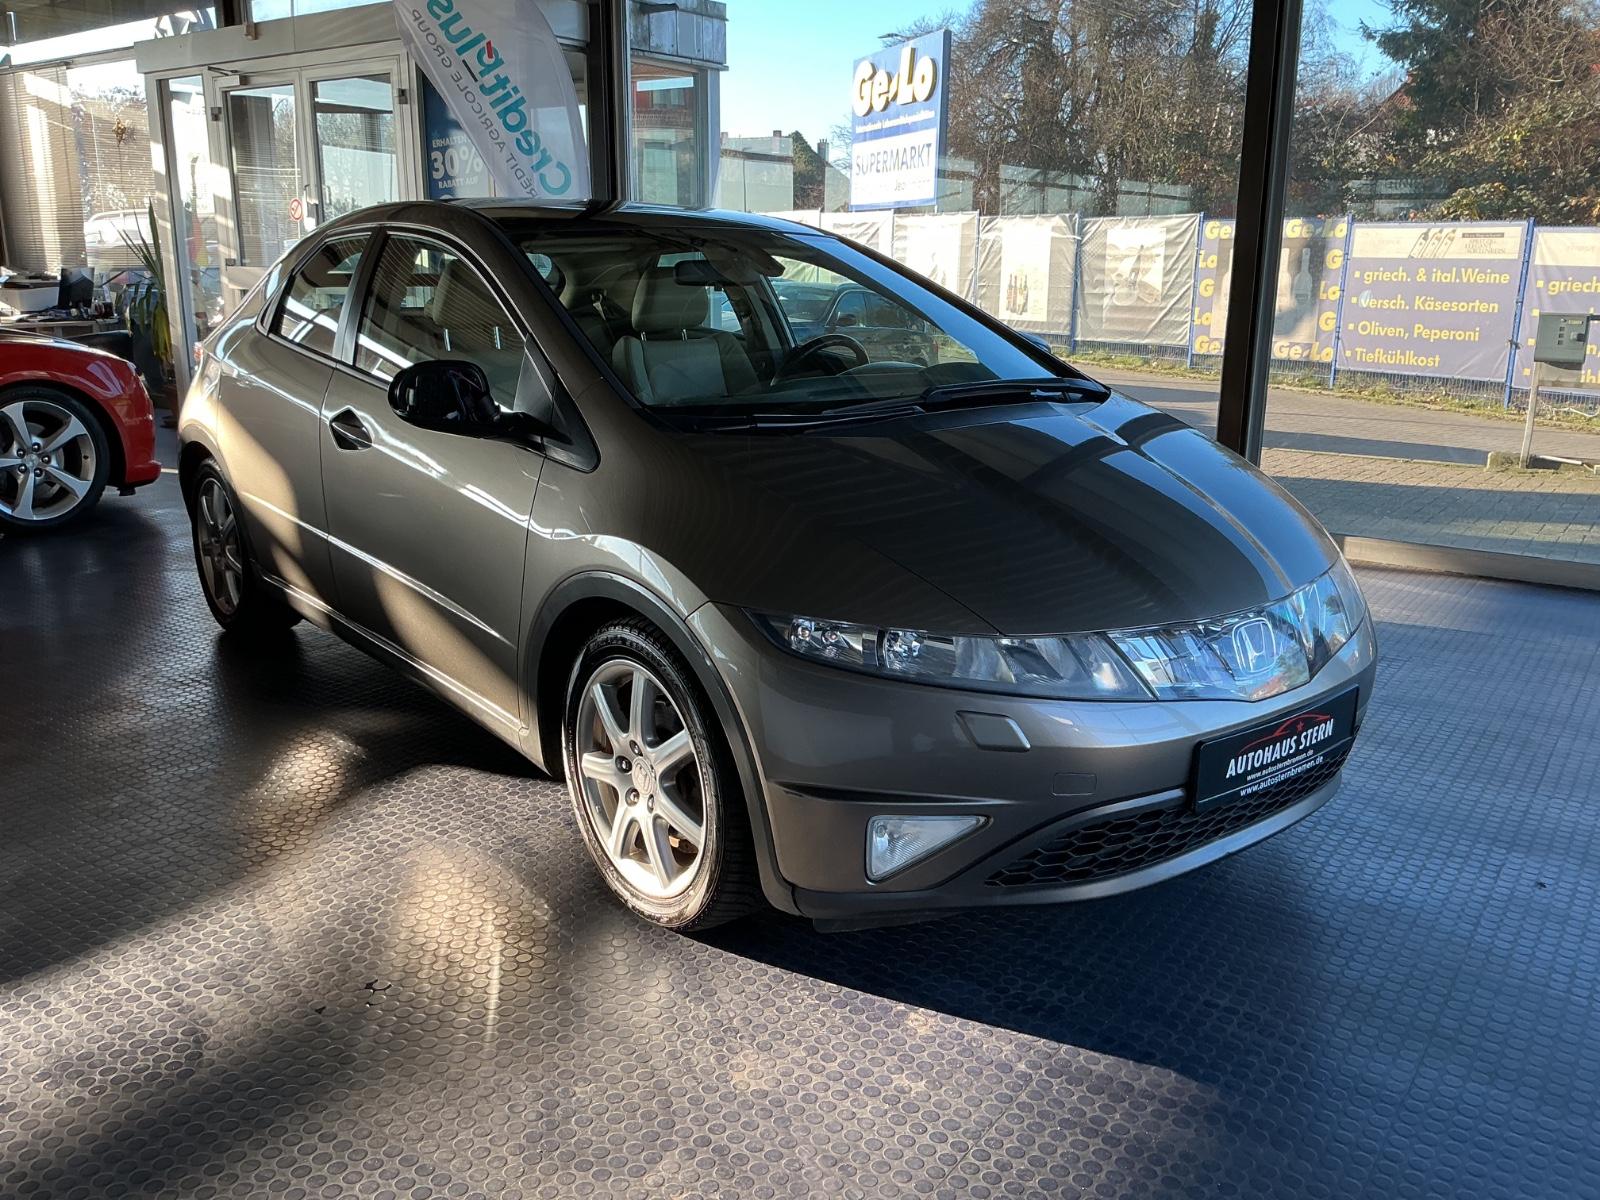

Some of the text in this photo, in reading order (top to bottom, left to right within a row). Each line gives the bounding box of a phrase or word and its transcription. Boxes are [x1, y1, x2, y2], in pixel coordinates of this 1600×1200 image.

[431, 146, 484, 180] 30%
[855, 143, 932, 176] SUPERMARKT
[1363, 267, 1411, 284] griech.
[1416, 268, 1427, 282] &
[1414, 295, 1499, 313] Käsesorten
[1358, 321, 1480, 343] Oliven, Peperoni
[1354, 347, 1441, 368] Tiefkühlkost
[1225, 718, 1334, 779] AUTOHAUS STERN
[1240, 756, 1324, 797] www.autosternbremen.de
